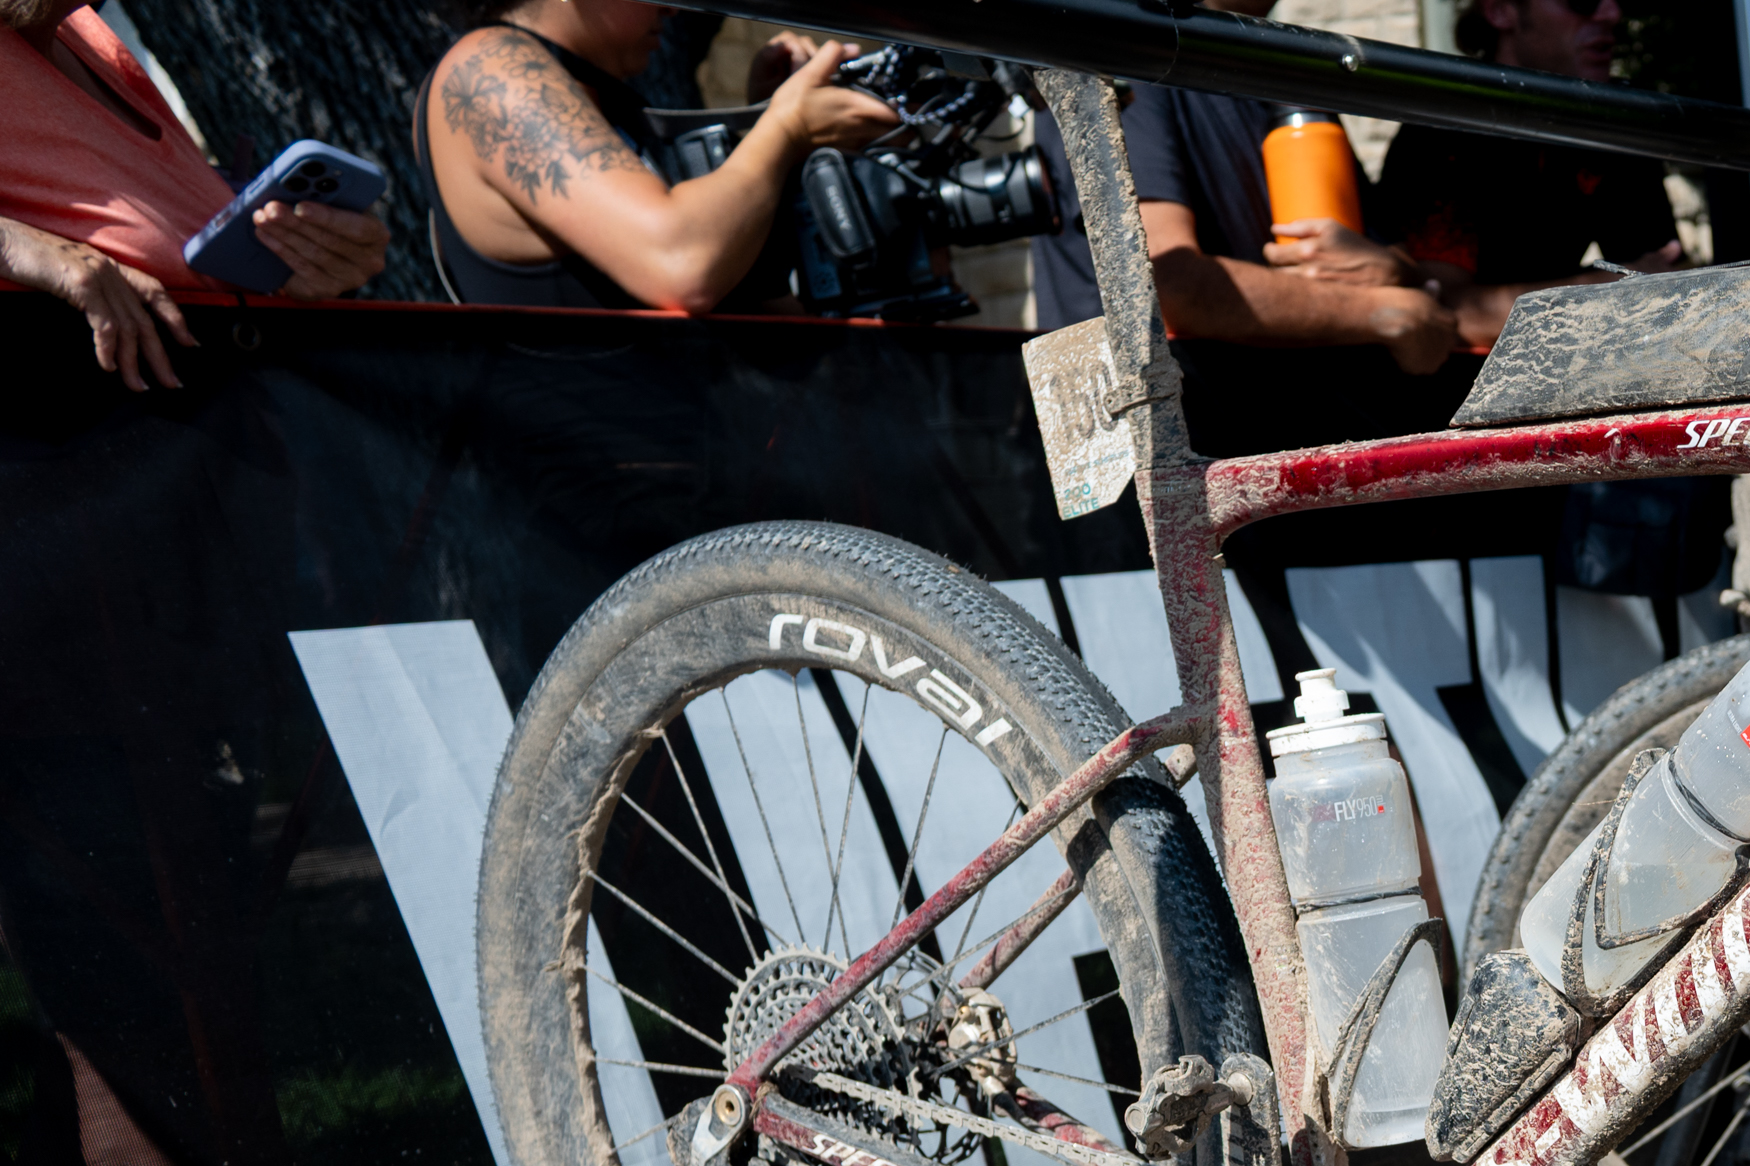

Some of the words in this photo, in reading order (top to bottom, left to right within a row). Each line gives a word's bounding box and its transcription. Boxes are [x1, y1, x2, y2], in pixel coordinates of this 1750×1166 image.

[825, 184, 853, 230] SONY
[1061, 497, 1101, 519] ELITE
[1063, 482, 1092, 501] 200
[768, 613, 1013, 748] roval
